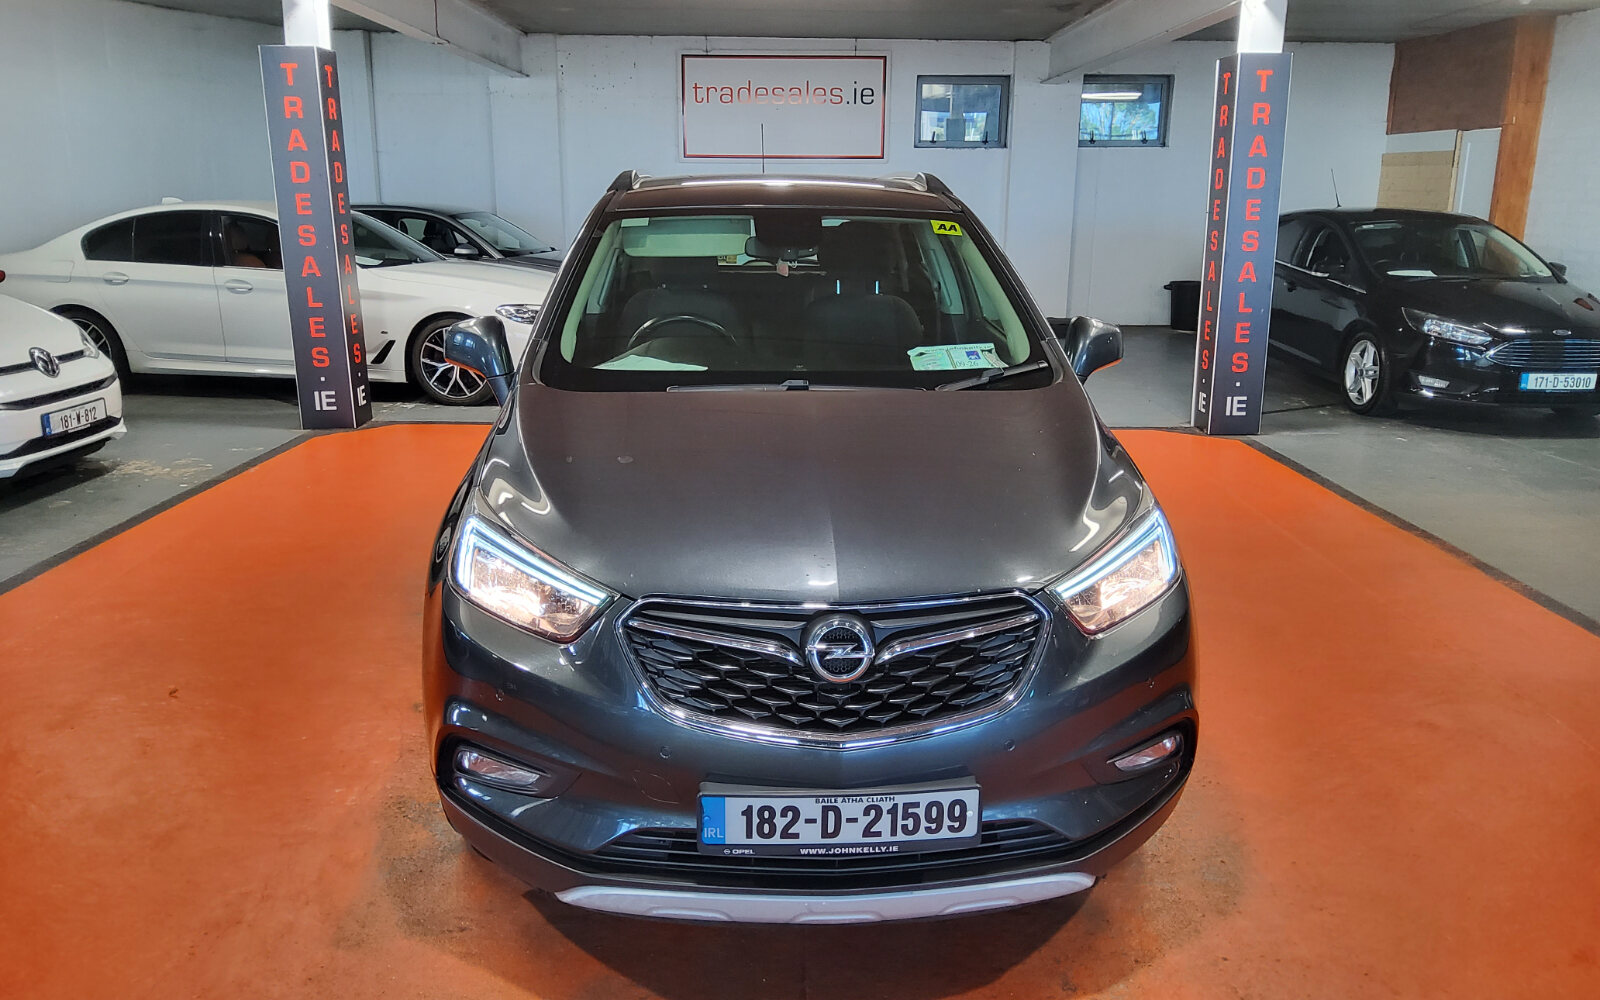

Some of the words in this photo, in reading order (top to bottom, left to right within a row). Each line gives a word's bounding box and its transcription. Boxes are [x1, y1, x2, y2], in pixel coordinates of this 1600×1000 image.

[692, 80, 875, 105] tradesales.ie
[937, 223, 958, 232] AA
[1534, 376, 1592, 388] 171-D-53010
[866, 795, 896, 803] CLIATH
[741, 798, 968, 840] 182-D-21599
[704, 827, 724, 838] IRL
[799, 845, 900, 855] WWW.JOHNKELLY.IE
